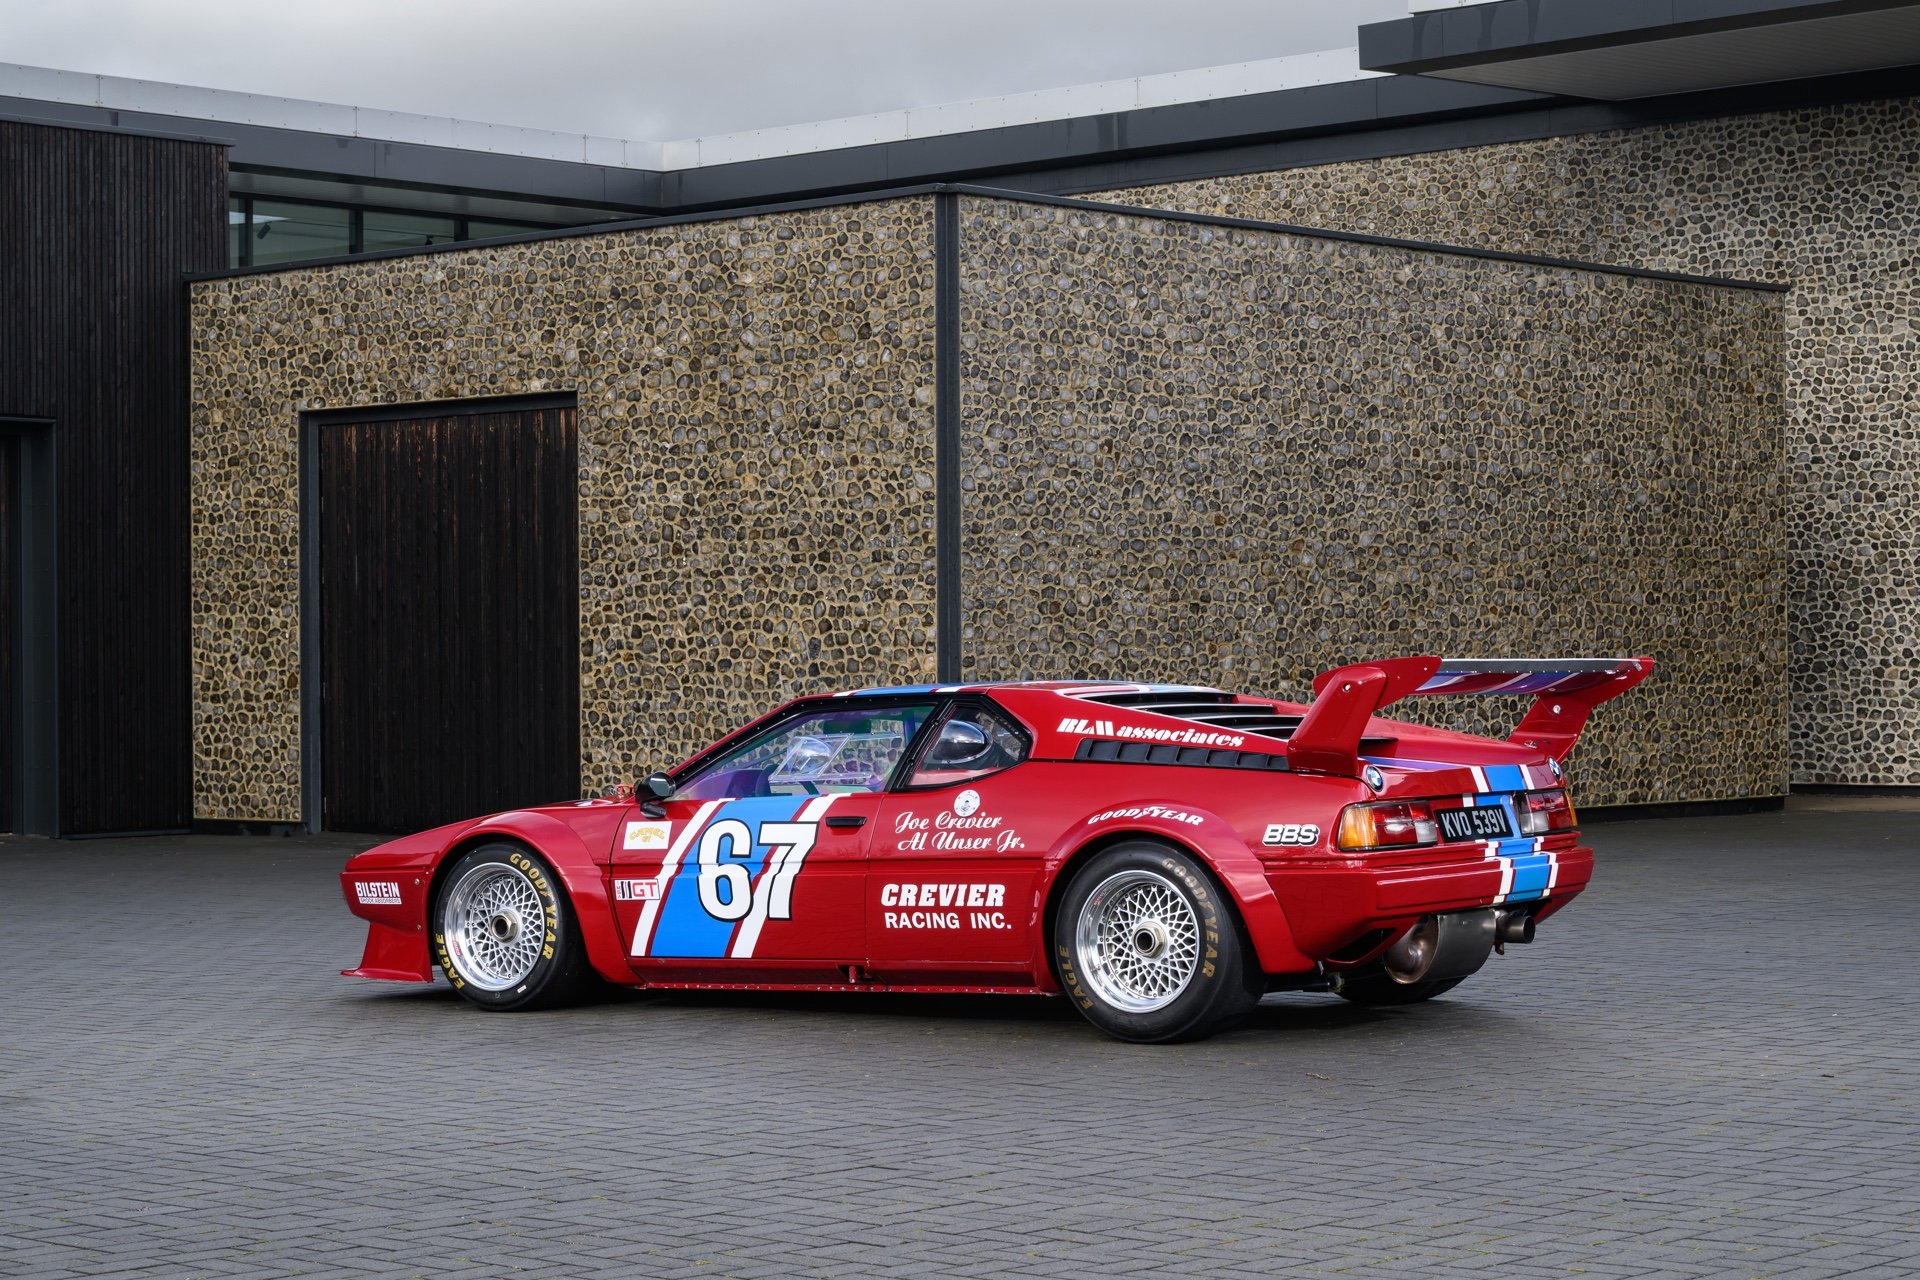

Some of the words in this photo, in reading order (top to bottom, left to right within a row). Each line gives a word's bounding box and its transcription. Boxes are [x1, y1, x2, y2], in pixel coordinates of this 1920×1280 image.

[1116, 725, 1245, 747] associates
[895, 811, 930, 833] Joe
[935, 811, 1002, 830] Crevier
[1087, 805, 1204, 826] GOODYEAR
[1441, 811, 1472, 838] KVO
[1472, 808, 1507, 835] 539V
[630, 828, 664, 840] CAMEL
[897, 831, 929, 851] Al
[931, 831, 992, 851] Unser
[996, 829, 1025, 853] Jr.
[1262, 823, 1321, 847] BBS
[697, 818, 819, 923] 67
[354, 881, 401, 897] BILSTEIN
[632, 882, 657, 897] GT
[880, 883, 1006, 907] CREVIER
[509, 852, 558, 961] GOODYEAR
[1162, 857, 1220, 979] GOODYEAR
[884, 912, 960, 929] RACING
[970, 912, 1012, 929] INC.
[434, 932, 465, 990] EAGLE
[1059, 944, 1095, 1010] EAGLE
